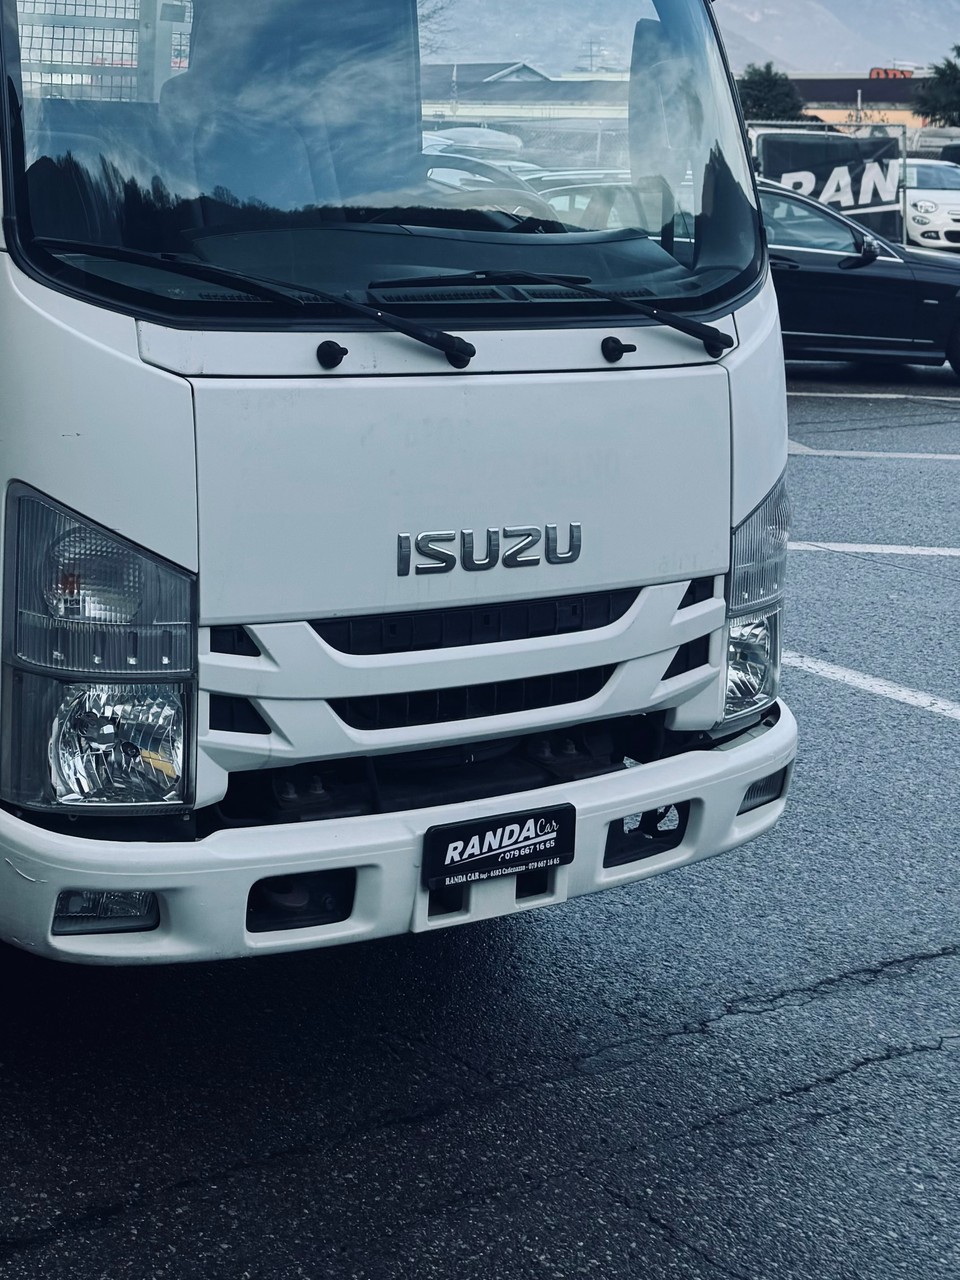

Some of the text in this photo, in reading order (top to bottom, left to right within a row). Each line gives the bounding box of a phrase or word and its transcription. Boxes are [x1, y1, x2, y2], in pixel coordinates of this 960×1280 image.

[397, 522, 581, 576] ISUZU
[444, 818, 559, 865] RANDA Car
[504, 840, 555, 860] 079 667 16 65
[445, 874, 466, 885] RANDA
[467, 872, 479, 881] CAR
